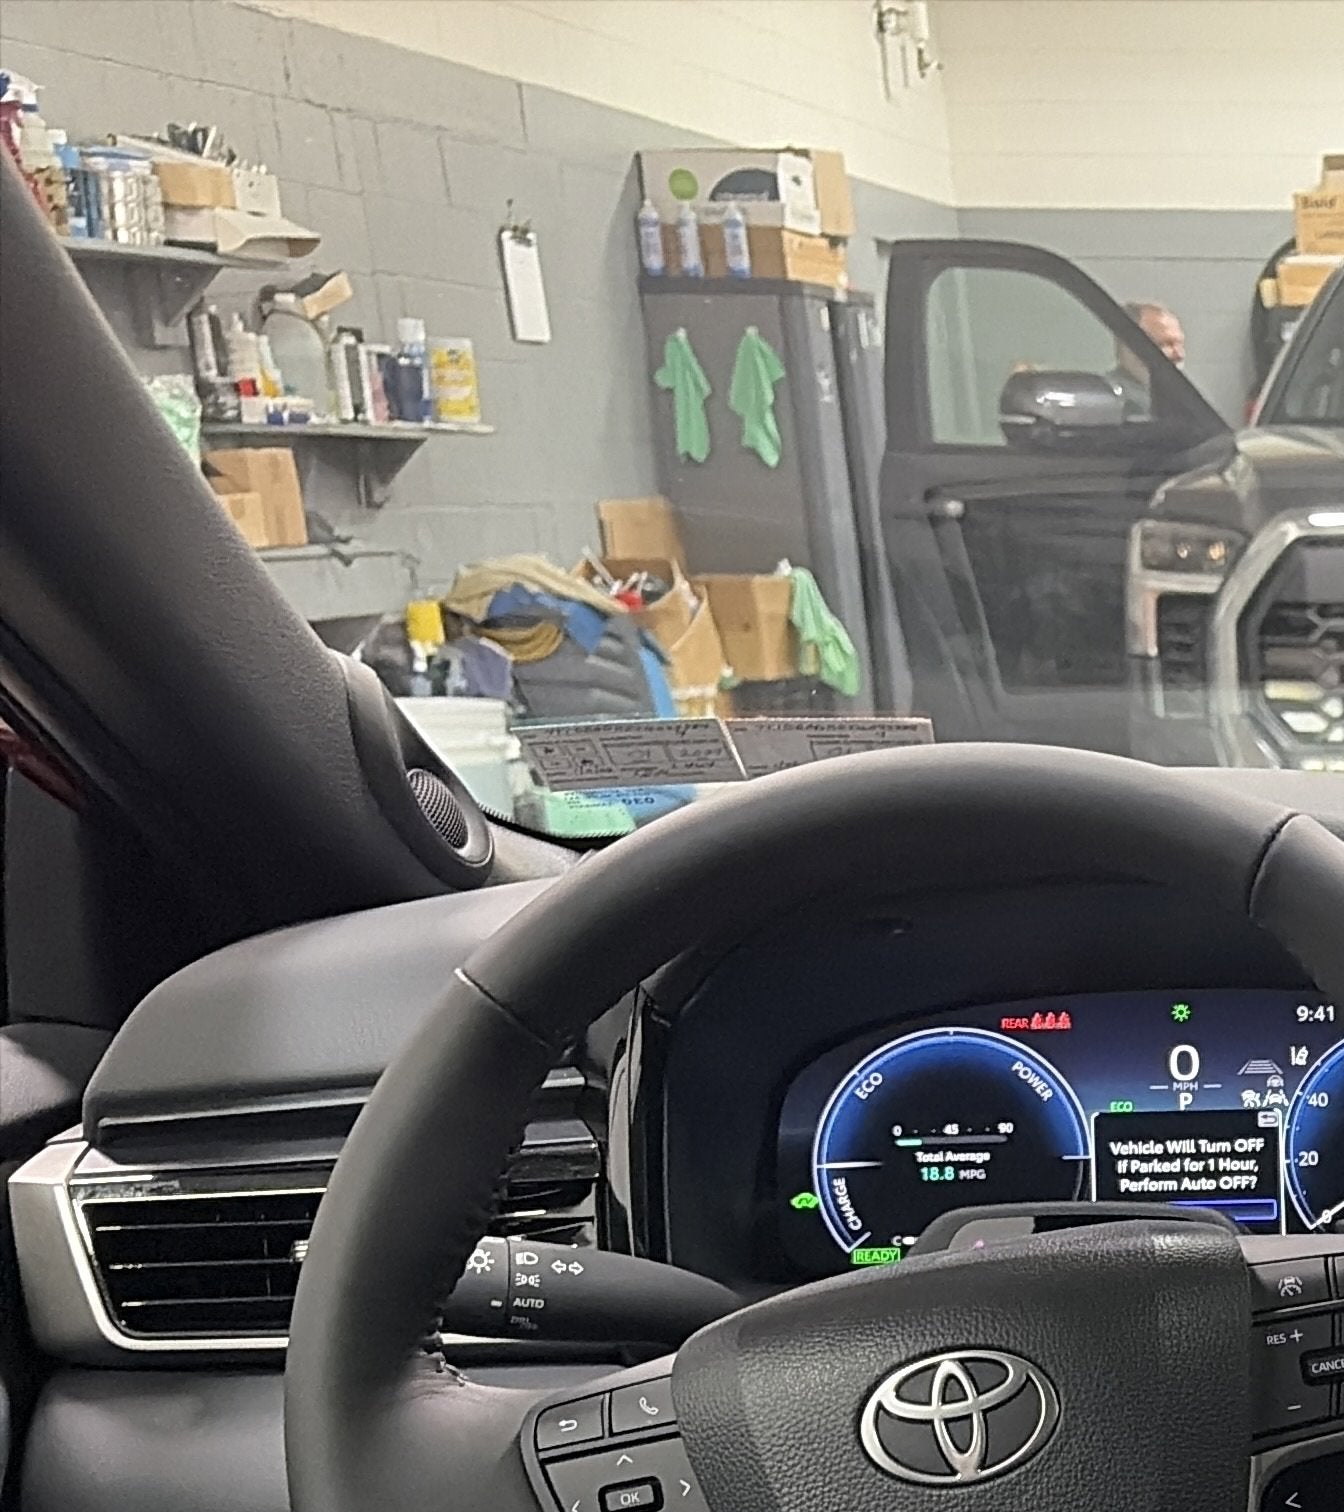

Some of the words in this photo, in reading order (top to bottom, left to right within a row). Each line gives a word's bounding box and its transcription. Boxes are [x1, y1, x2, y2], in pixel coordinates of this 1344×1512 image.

[1296, 1005, 1335, 1022] 9:41
[1001, 1017, 1029, 1030] REAR
[1169, 1044, 1200, 1082] 0
[854, 1071, 883, 1101] ECO
[1010, 1060, 1054, 1103] POWER
[1172, 1081, 1199, 1091] MPH
[1110, 1101, 1133, 1113] ECO
[1179, 1092, 1193, 1111] P
[1308, 1092, 1329, 1108] 40
[892, 1125, 903, 1137] 0
[943, 1123, 959, 1136] 45
[998, 1122, 1014, 1134] 90
[1109, 1139, 1164, 1156] Vehicle
[1165, 1139, 1196, 1155] Will
[1197, 1139, 1231, 1154] Turn
[1234, 1137, 1265, 1152] OFF
[915, 1151, 944, 1163] Total
[945, 1150, 991, 1165] Average
[1117, 1159, 1129, 1174] If
[1130, 1158, 1181, 1174] Parked
[1183, 1158, 1205, 1172] for
[1208, 1158, 1215, 1172] 1
[1218, 1157, 1259, 1173] Hour,
[1299, 1150, 1319, 1166] 20
[920, 1167, 955, 1181] 18.8
[959, 1169, 986, 1181] MPG
[1119, 1177, 1178, 1193] Perform
[1180, 1176, 1217, 1192] Auto
[1219, 1175, 1258, 1190] OFF?
[833, 1176, 863, 1232] CHARGE
[855, 1250, 899, 1263] READY
[513, 1298, 545, 1309] AUTO
[1266, 1333, 1287, 1345] RES
[620, 1491, 640, 1505] OK
